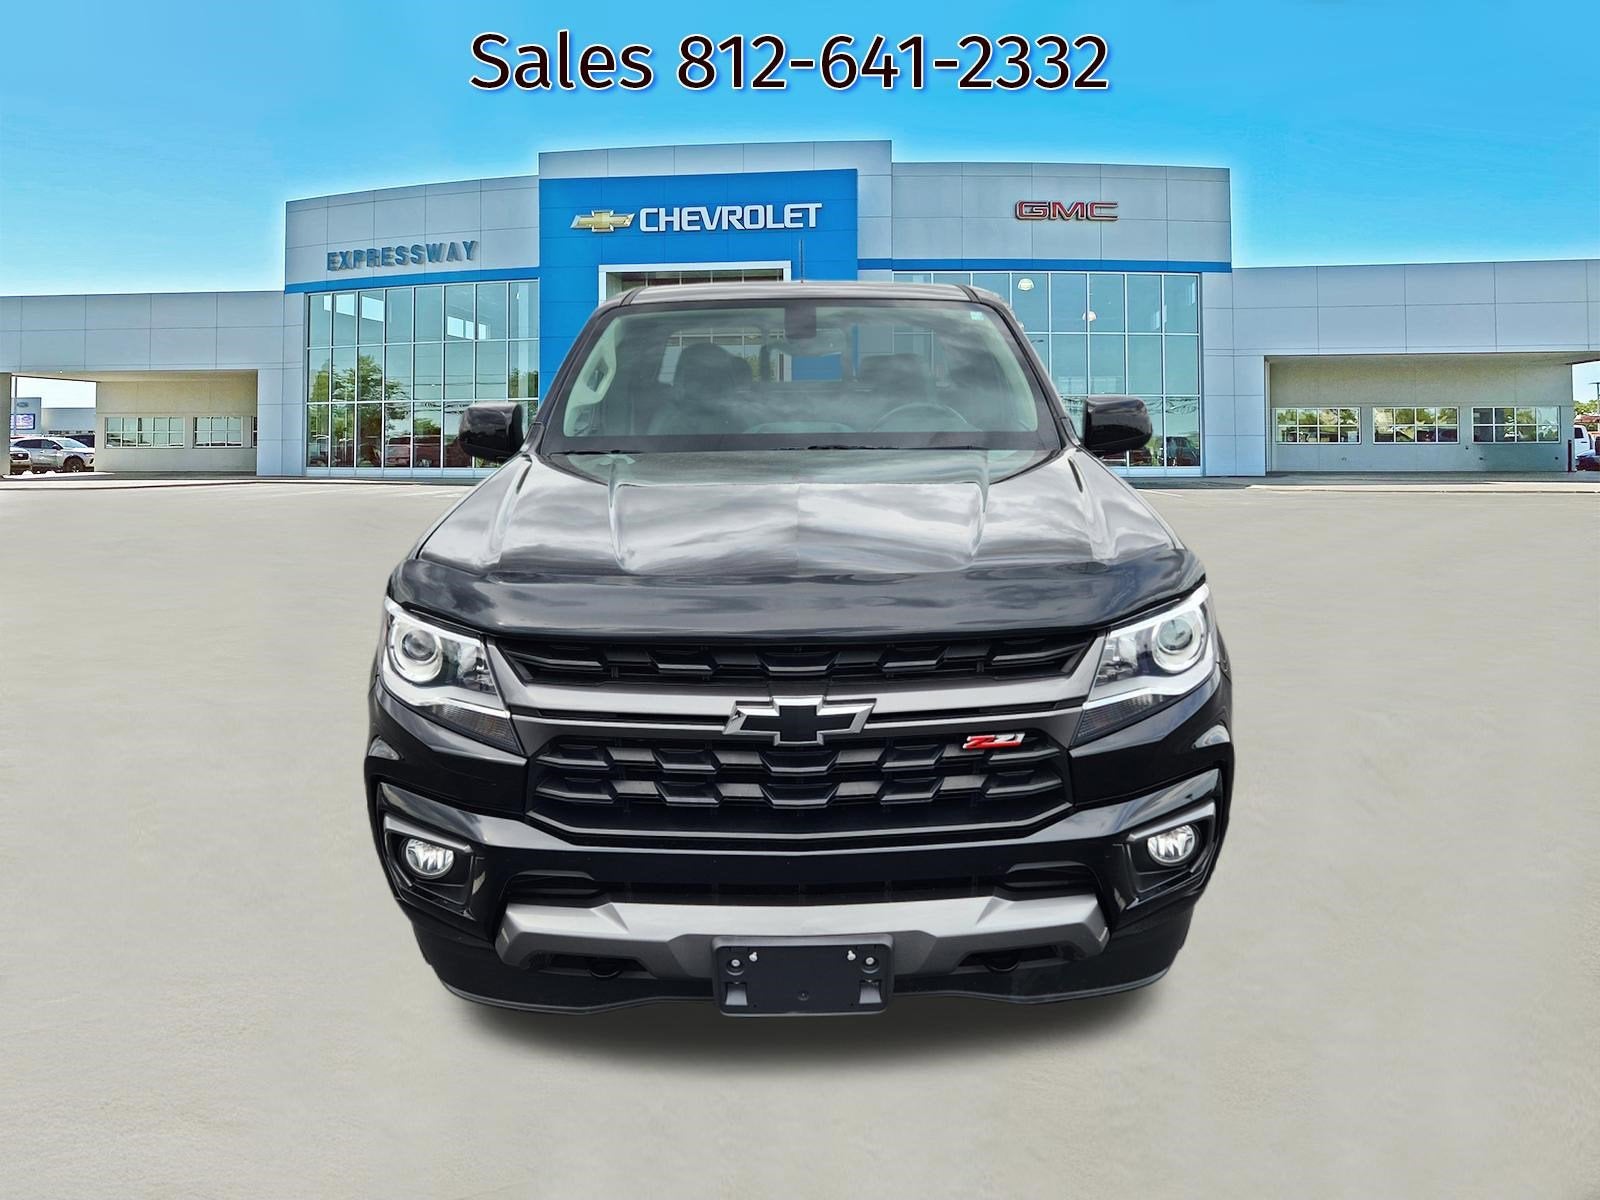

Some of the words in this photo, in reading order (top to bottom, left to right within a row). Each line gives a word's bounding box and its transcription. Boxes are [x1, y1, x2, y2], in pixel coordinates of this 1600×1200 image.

[639, 203, 823, 232] CHEVROLET
[1015, 200, 1119, 221] GMC
[326, 240, 478, 271] EXPRESSWAY
[962, 732, 1026, 750] Z71
